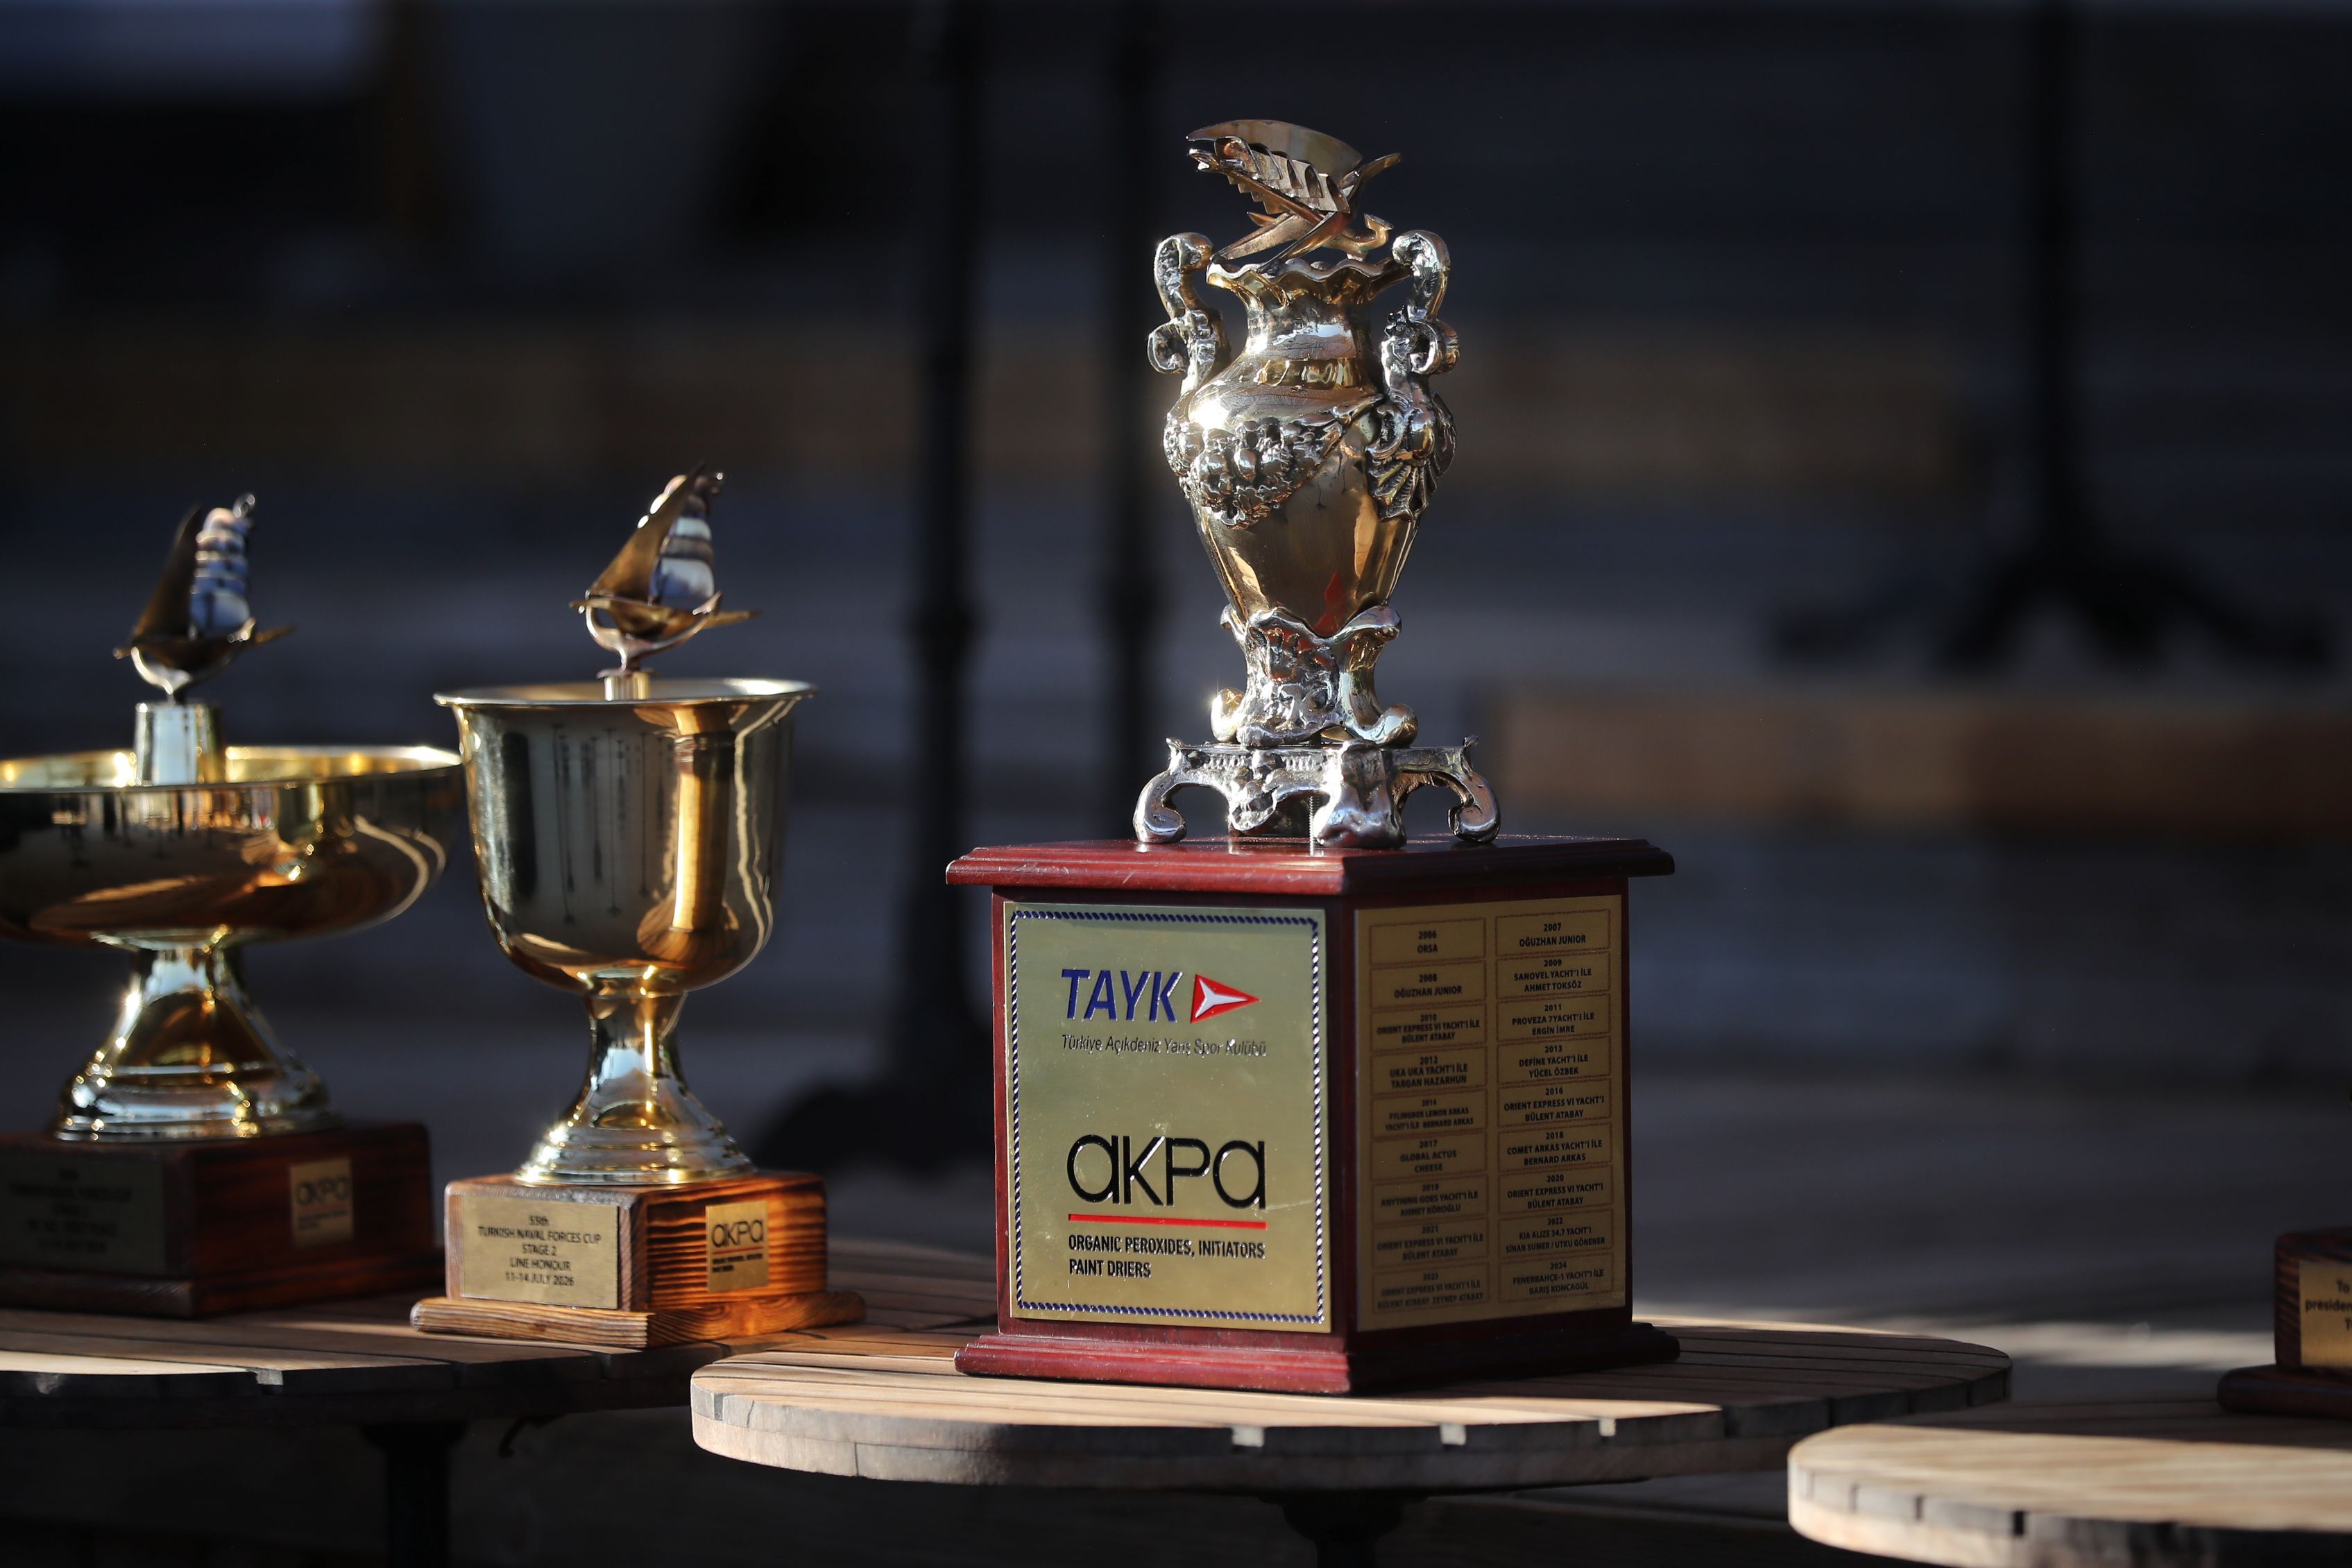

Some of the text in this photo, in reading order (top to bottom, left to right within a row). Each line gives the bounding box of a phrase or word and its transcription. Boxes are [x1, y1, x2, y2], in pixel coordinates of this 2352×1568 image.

[1544, 923, 1562, 932] 2007
[1418, 930, 1437, 939] 2006
[1519, 935, 1586, 947] OĞUZHAN JUNIOR
[1417, 944, 1438, 953] ORSA
[1419, 973, 1437, 982] 2008
[1514, 967, 1592, 981] SANOVEL YACHT'I İLE
[1394, 985, 1462, 998] OĞUZHAN JUNIOR
[1524, 980, 1582, 992] AHMET TOKSÖZ
[1062, 969, 1183, 1023] TAYK
[1420, 1014, 1437, 1022] 2010
[1512, 1016, 1546, 1025] PROVEZA
[1583, 1012, 1595, 1021] İLE
[1404, 1023, 1433, 1033] EXPRESS
[1434, 1023, 1441, 1031] VI
[1469, 1019, 1480, 1028] İLE
[1532, 1025, 1575, 1035] ERGİN İMRE
[1430, 1032, 1456, 1041] ATABAY
[1062, 1034, 1102, 1055] Türkiye
[1105, 1036, 1161, 1055] Açıkdeniz
[1193, 1039, 1223, 1058] Spor
[1544, 1045, 1562, 1053] 2013
[1420, 1056, 1438, 1065] 2012
[1519, 1053, 1589, 1067] DEFİNE YACHT'I İLE
[1389, 1068, 1406, 1078] UKA
[1408, 1067, 1424, 1076] UKA
[1456, 1062, 1467, 1073] İLE
[1529, 1066, 1579, 1078] YÜCEL ÖZBEK
[1545, 1087, 1563, 1096] 2016
[1422, 1098, 1437, 1107] 2014
[1504, 1096, 1605, 1111] ORIENT EXPRESS VI YACHT'I
[1449, 1107, 1469, 1116] ARKAS
[1525, 1110, 1584, 1122] BÜLENT ATABAY
[1454, 1117, 1474, 1126] ARKAS
[1545, 1132, 1564, 1140] 2018
[1420, 1139, 1438, 1149] 2017
[1507, 1139, 1603, 1155] COMET ARKAS YACHT'I İLE
[1400, 1150, 1457, 1162] GLOBAL ACTUS
[1524, 1153, 1586, 1166] BERNARD ARKAS
[1414, 1163, 1443, 1173] CHEESE
[1546, 1175, 1565, 1183] 2020
[1422, 1183, 1439, 1192] 2019
[1507, 1189, 1534, 1199] ORIENT
[1535, 1186, 1566, 1196] EXPRESS
[1576, 1183, 1603, 1193] YACHT'I
[1420, 1194, 1438, 1204] GOES
[1468, 1190, 1478, 1199] İLE
[1527, 1197, 1584, 1209] BÜLENT ATABAY
[1400, 1207, 1426, 1217] AHMET
[1547, 1218, 1563, 1226] 2022
[1422, 1225, 1438, 1234] 2021
[1519, 1232, 1530, 1240] KIA
[1532, 1230, 1550, 1239] ALIZE
[1567, 1226, 1592, 1236] YACHT'I
[478, 1226, 602, 1245] TURKISH NAVAL FORCES CUP
[1473, 1233, 1484, 1242] İLE
[522, 1244, 549, 1256] STAGE
[1068, 1234, 1266, 1259] ORGANIC PEROXIDES, INITIATORS
[1506, 1244, 1526, 1253] SİNAN
[1555, 1240, 1573, 1249] UTKU
[1574, 1237, 1605, 1247] GÖNENER
[1431, 1247, 1458, 1258] ATABAY
[509, 1256, 571, 1272] LINE HONOUR
[1069, 1259, 1152, 1279] PAINT DRIERS
[1550, 1261, 1567, 1270] 2024
[1593, 1268, 1604, 1277] İLE
[1529, 1286, 1550, 1295] BARIŞ
